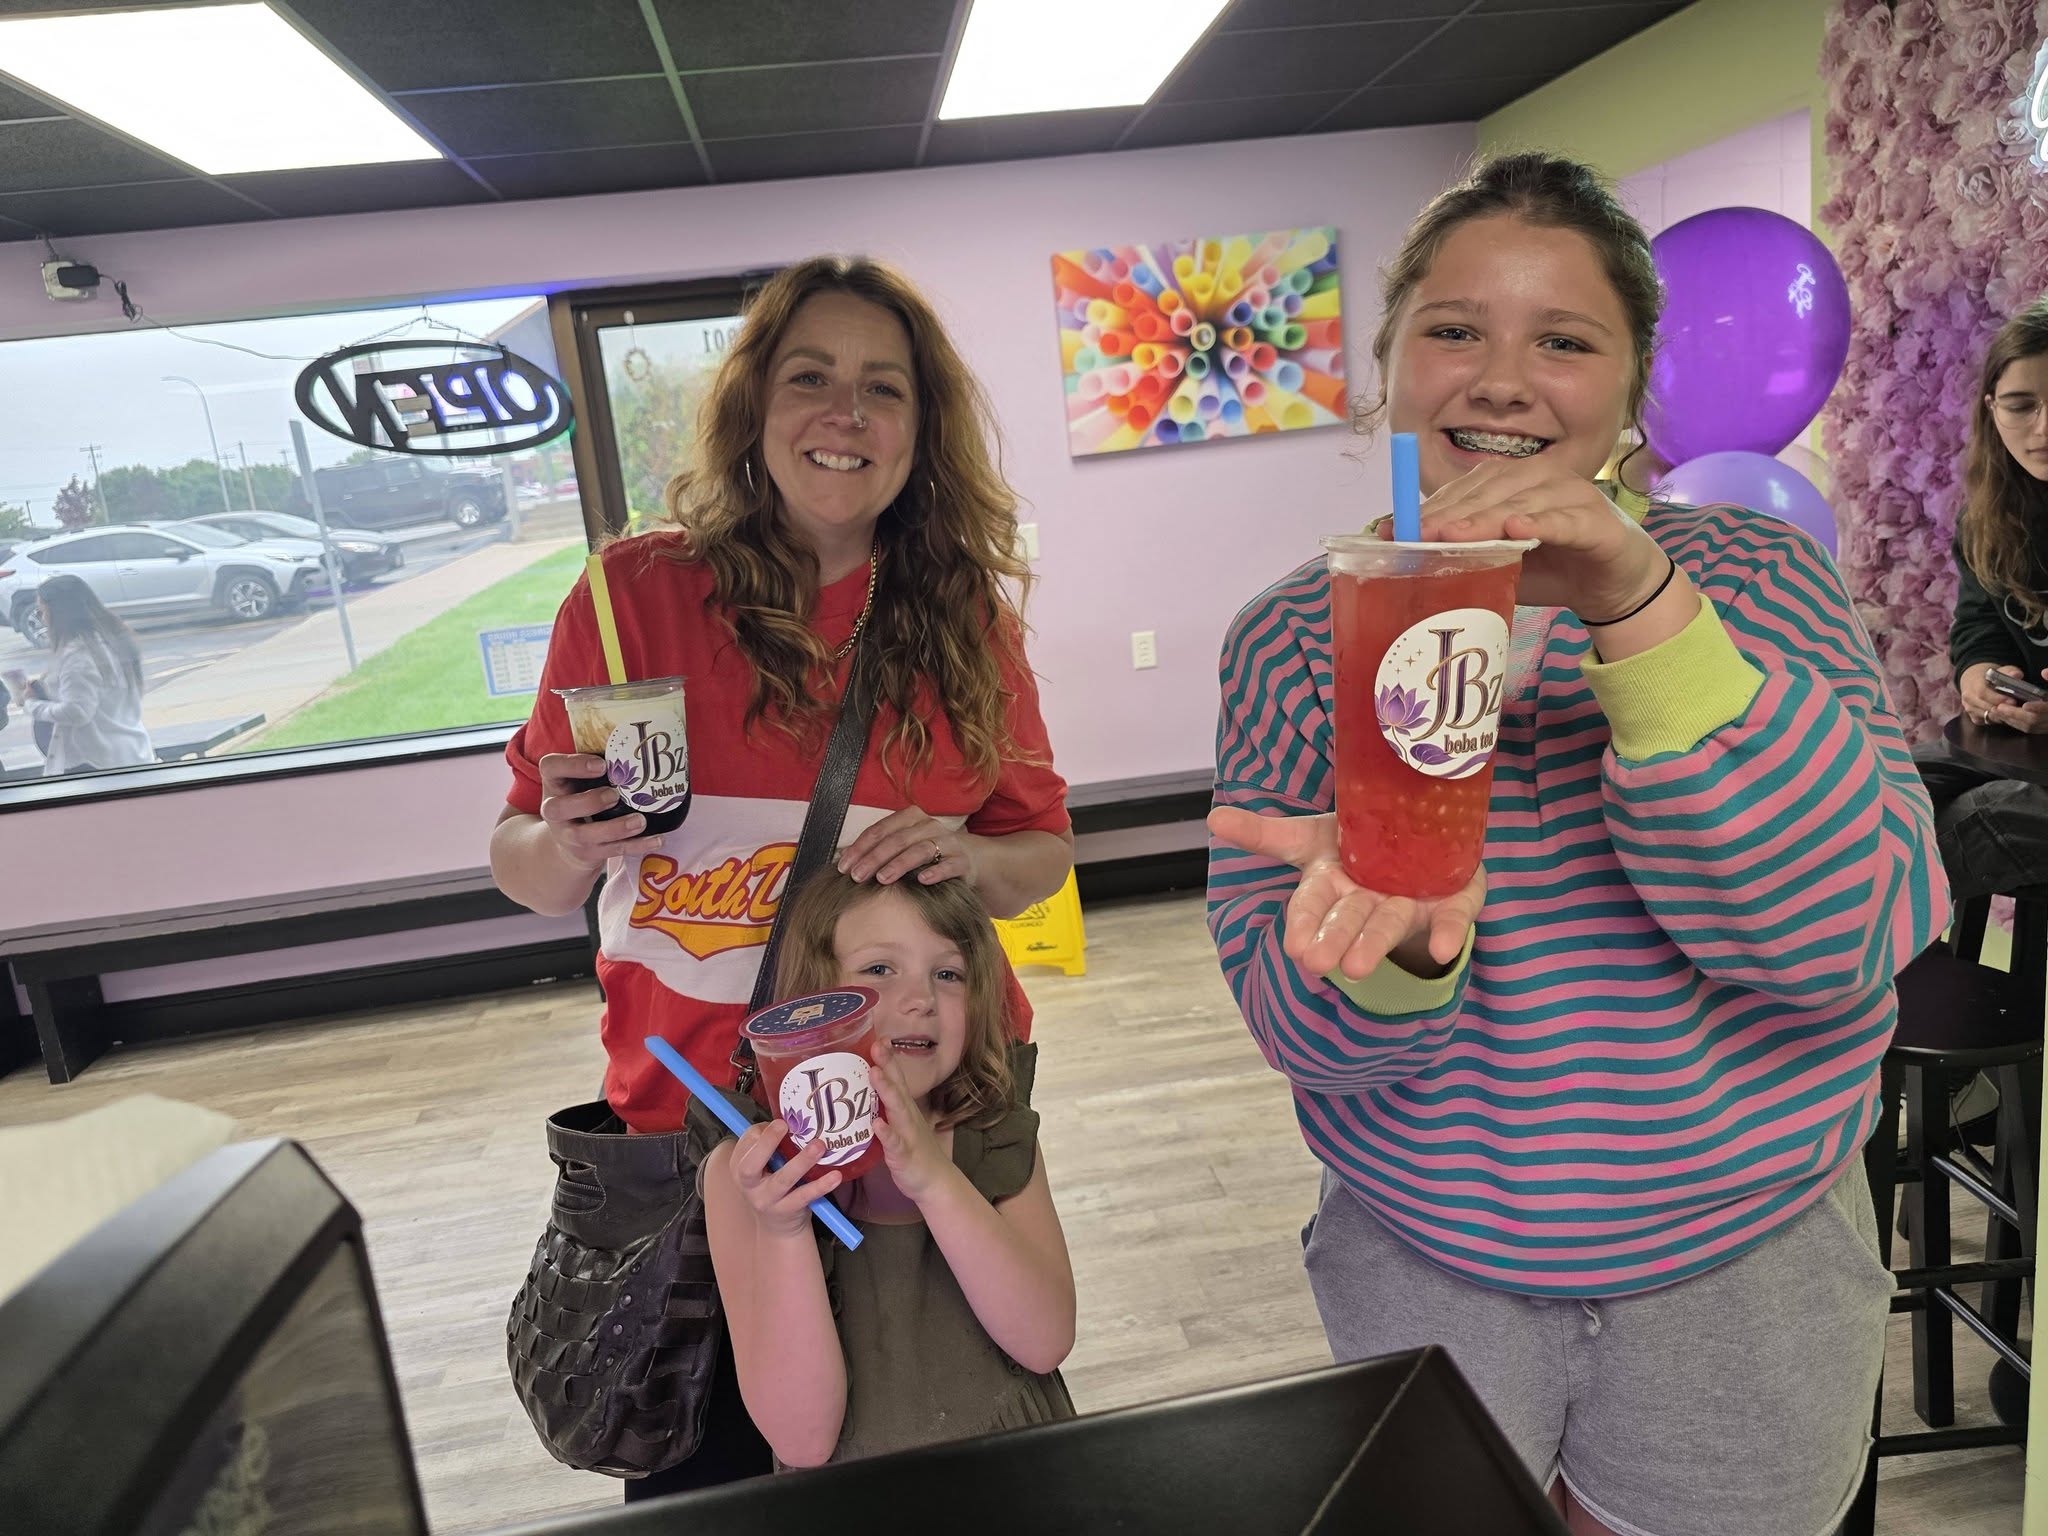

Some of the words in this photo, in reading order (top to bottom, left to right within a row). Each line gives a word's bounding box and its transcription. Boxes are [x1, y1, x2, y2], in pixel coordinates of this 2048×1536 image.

[1443, 732, 1477, 754] boba
[1480, 730, 1494, 749] tea
[650, 782, 674, 798] boba
[674, 782, 685, 793] tea
[629, 853, 750, 921] South
[825, 1135, 854, 1151] boba
[854, 1127, 870, 1143] tea
